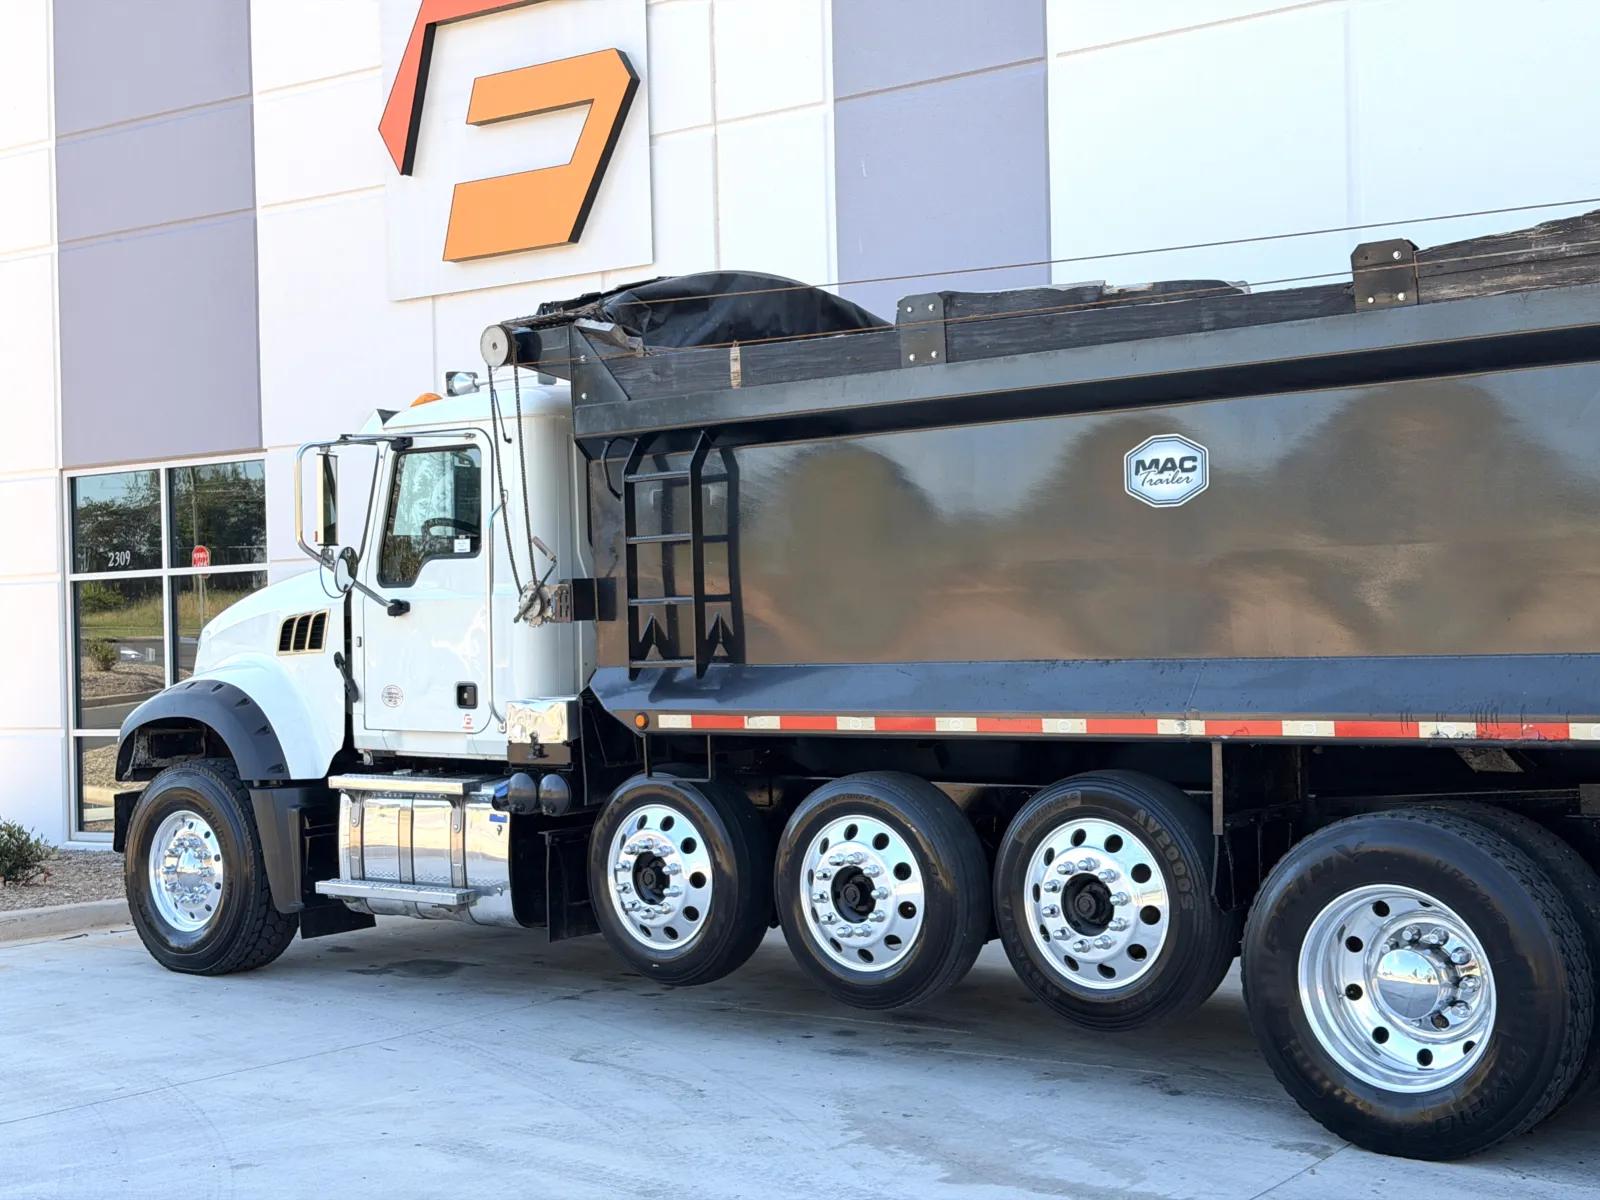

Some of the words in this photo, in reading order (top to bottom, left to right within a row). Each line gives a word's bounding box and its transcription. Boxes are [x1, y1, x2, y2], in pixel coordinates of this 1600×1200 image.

[1135, 456, 1198, 476] MAC
[1139, 469, 1193, 487] Trailer
[108, 551, 131, 567] 2309
